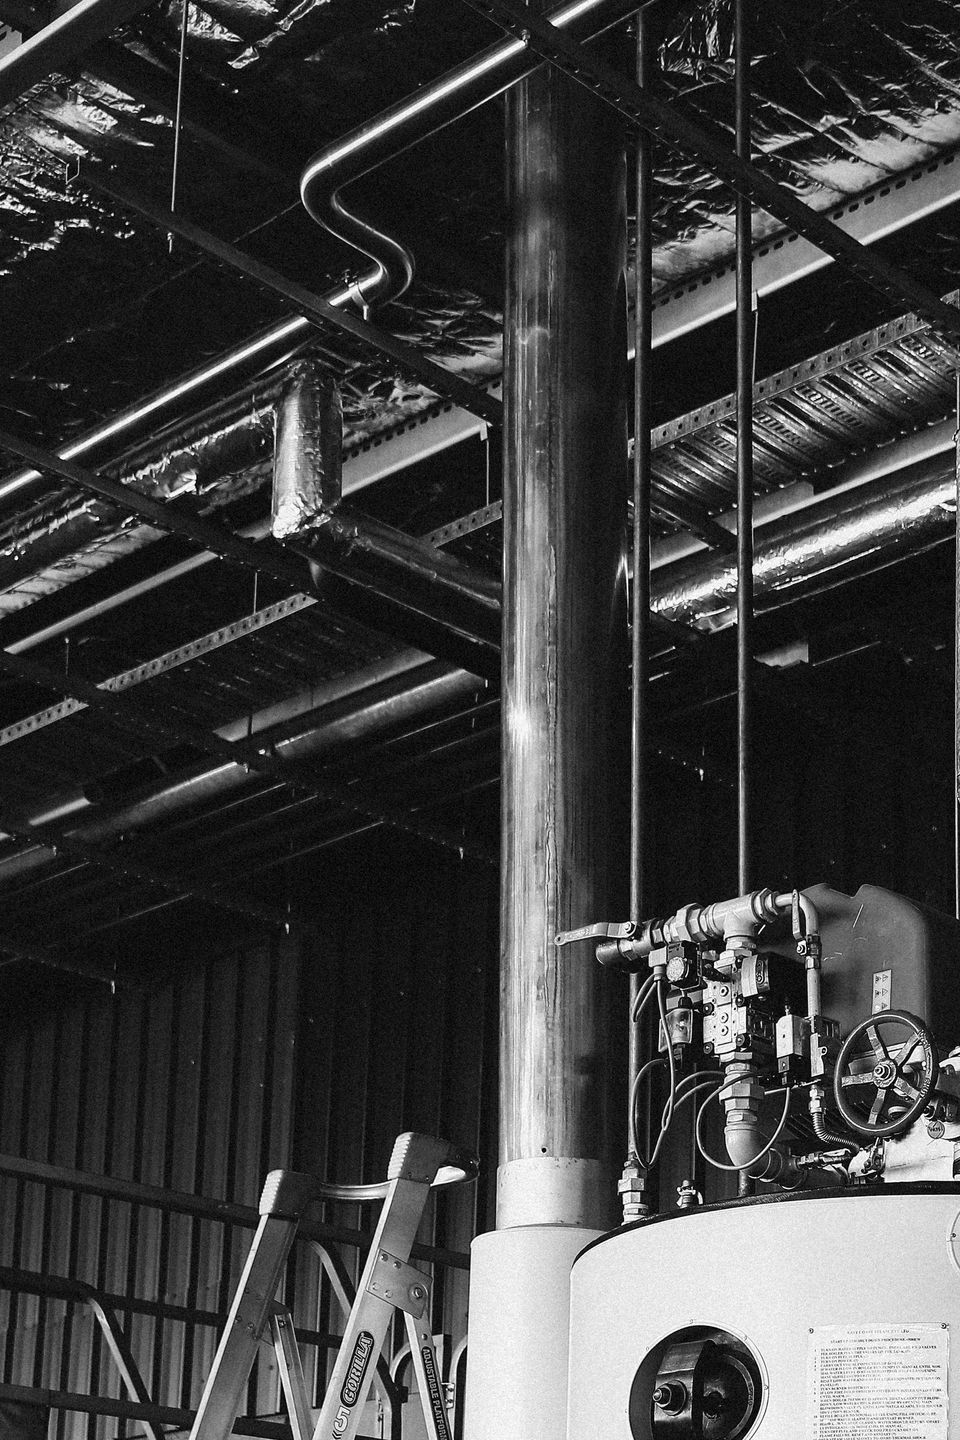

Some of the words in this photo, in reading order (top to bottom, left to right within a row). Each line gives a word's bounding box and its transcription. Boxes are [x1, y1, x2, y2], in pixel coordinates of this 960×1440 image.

[342, 1335, 373, 1402] GORILLA
[423, 1348, 439, 1398] ADJUSTABLE
[333, 1406, 351, 1433] 5
